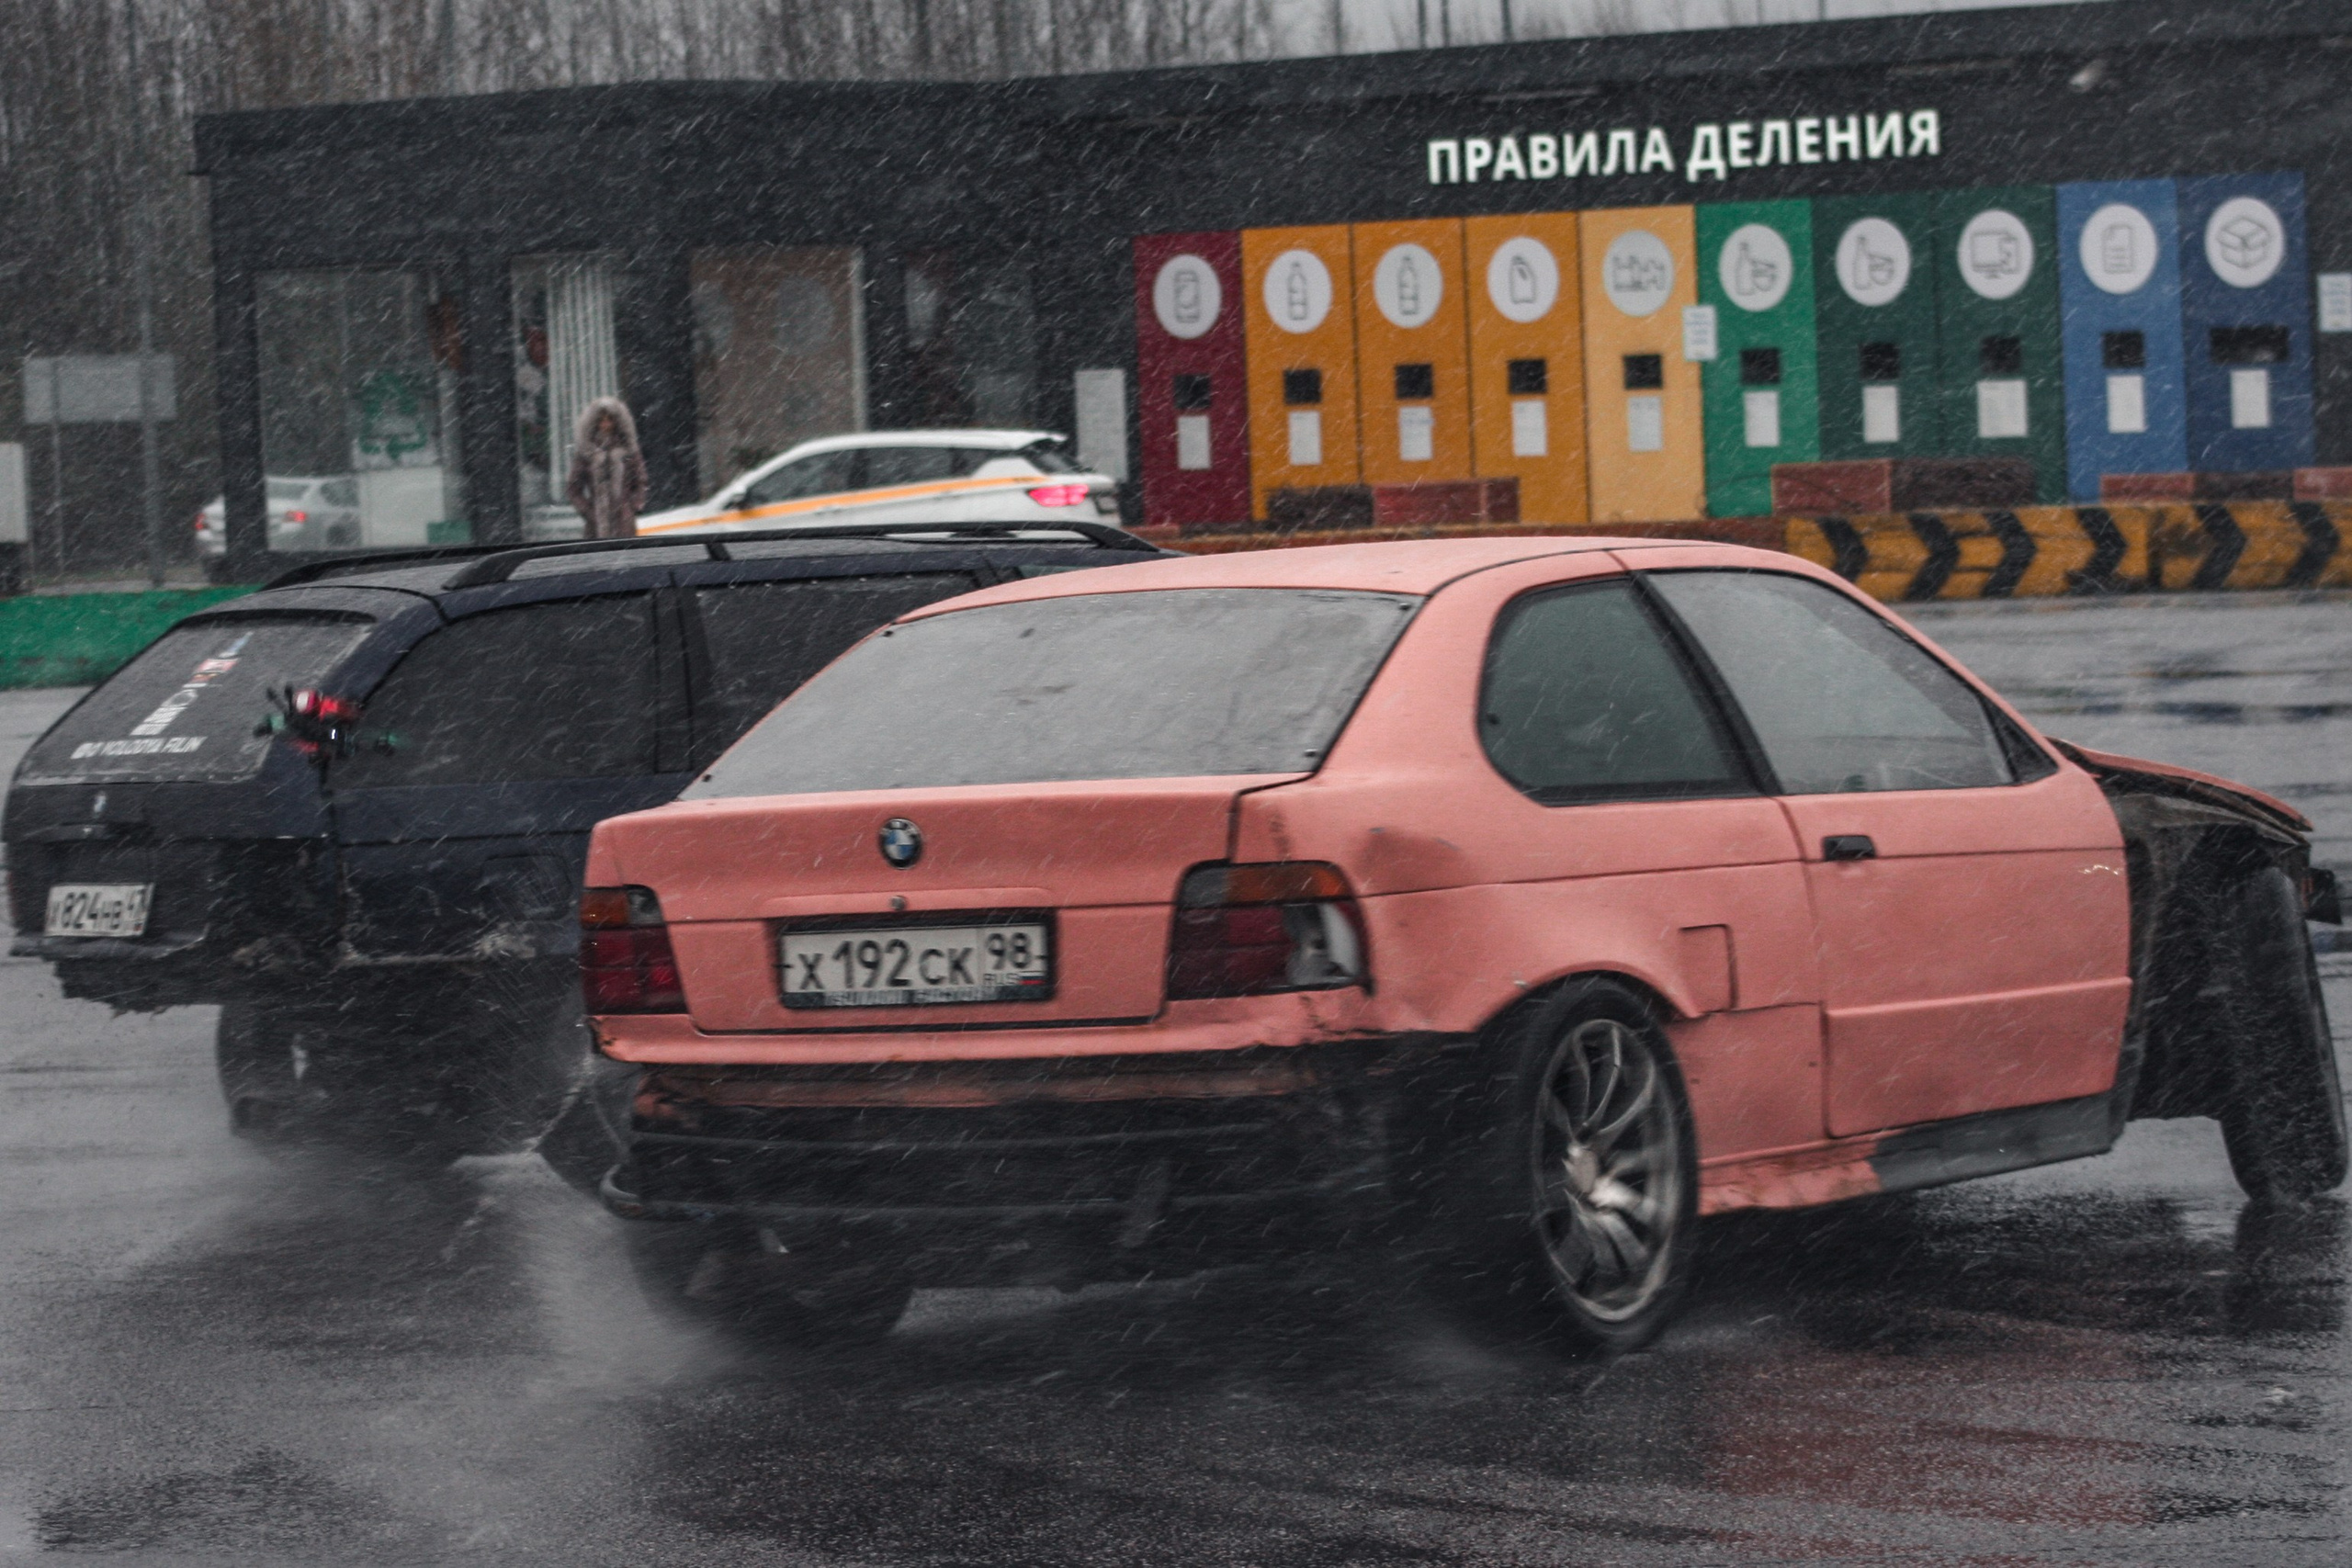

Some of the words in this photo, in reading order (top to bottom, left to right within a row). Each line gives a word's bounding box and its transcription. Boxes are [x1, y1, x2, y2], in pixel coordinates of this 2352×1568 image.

[1427, 128, 1676, 185] ПРАВИЛА
[1686, 109, 1940, 182] ДЕЛЕНИЯ
[986, 931, 1033, 970] 98
